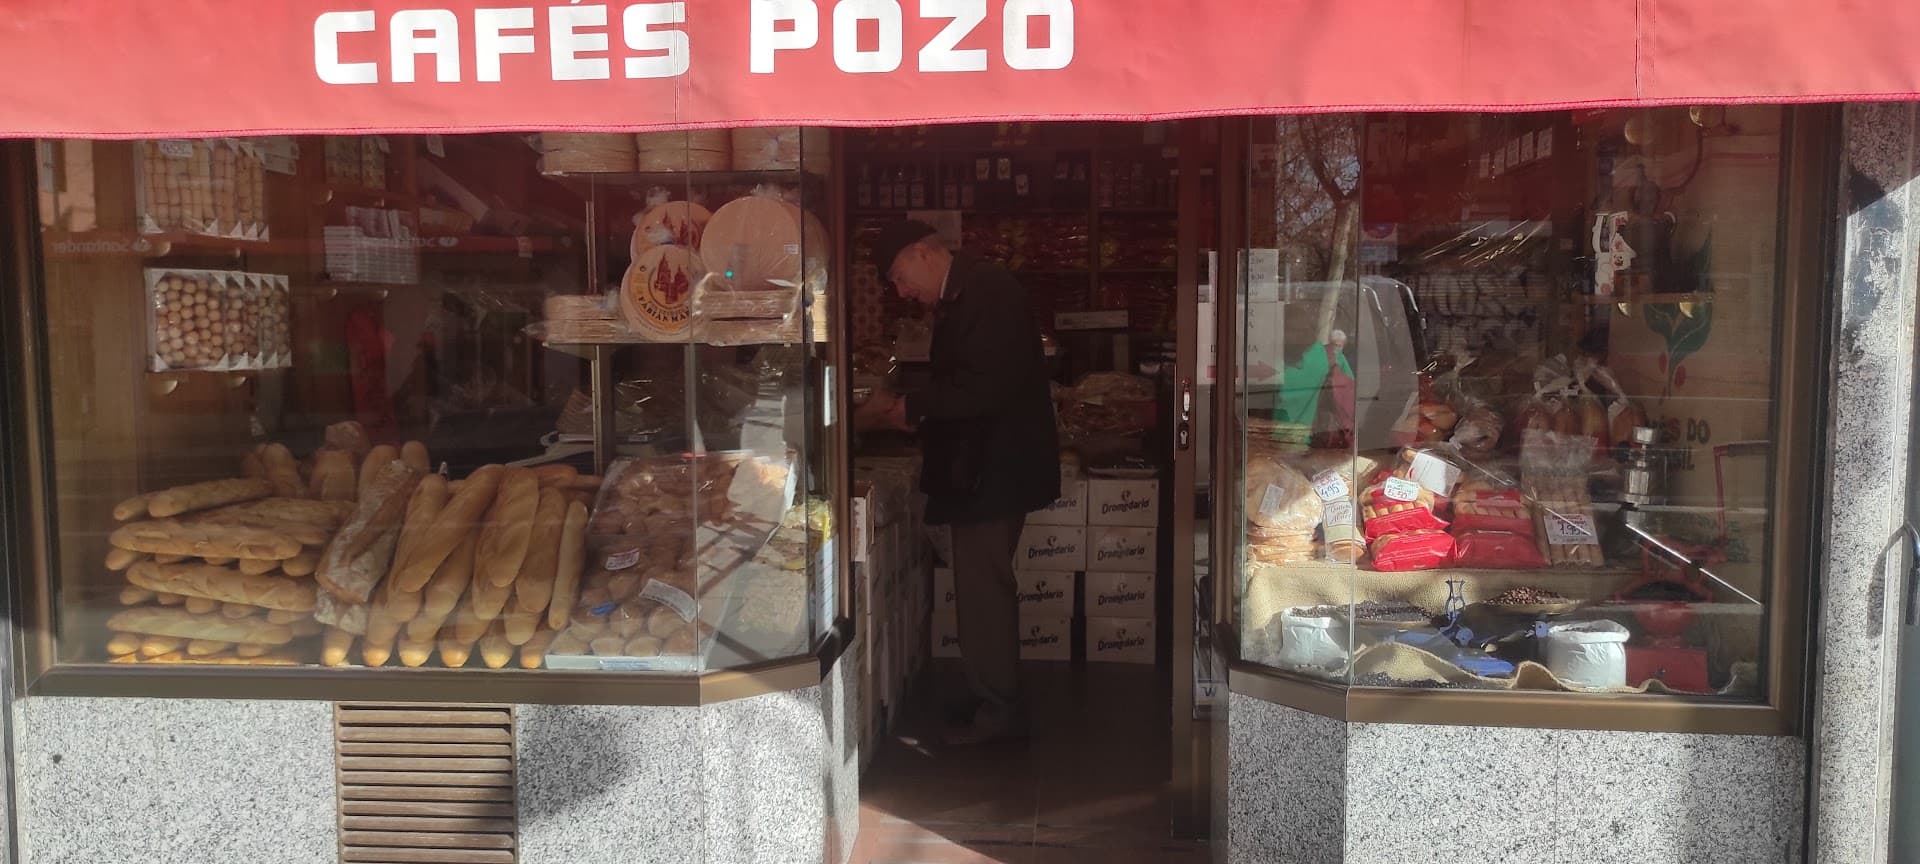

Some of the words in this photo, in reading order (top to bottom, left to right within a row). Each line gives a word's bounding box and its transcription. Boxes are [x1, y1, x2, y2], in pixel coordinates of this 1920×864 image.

[314, 0, 690, 84] CAFÉS
[750, 0, 1074, 74] POZO
[1102, 498, 1150, 514] Dromedario
[1028, 542, 1075, 559] Dromedario
[1097, 545, 1145, 561] Dromedario
[1097, 590, 1145, 606] Dromedario
[1097, 637, 1145, 652] Dromedario
